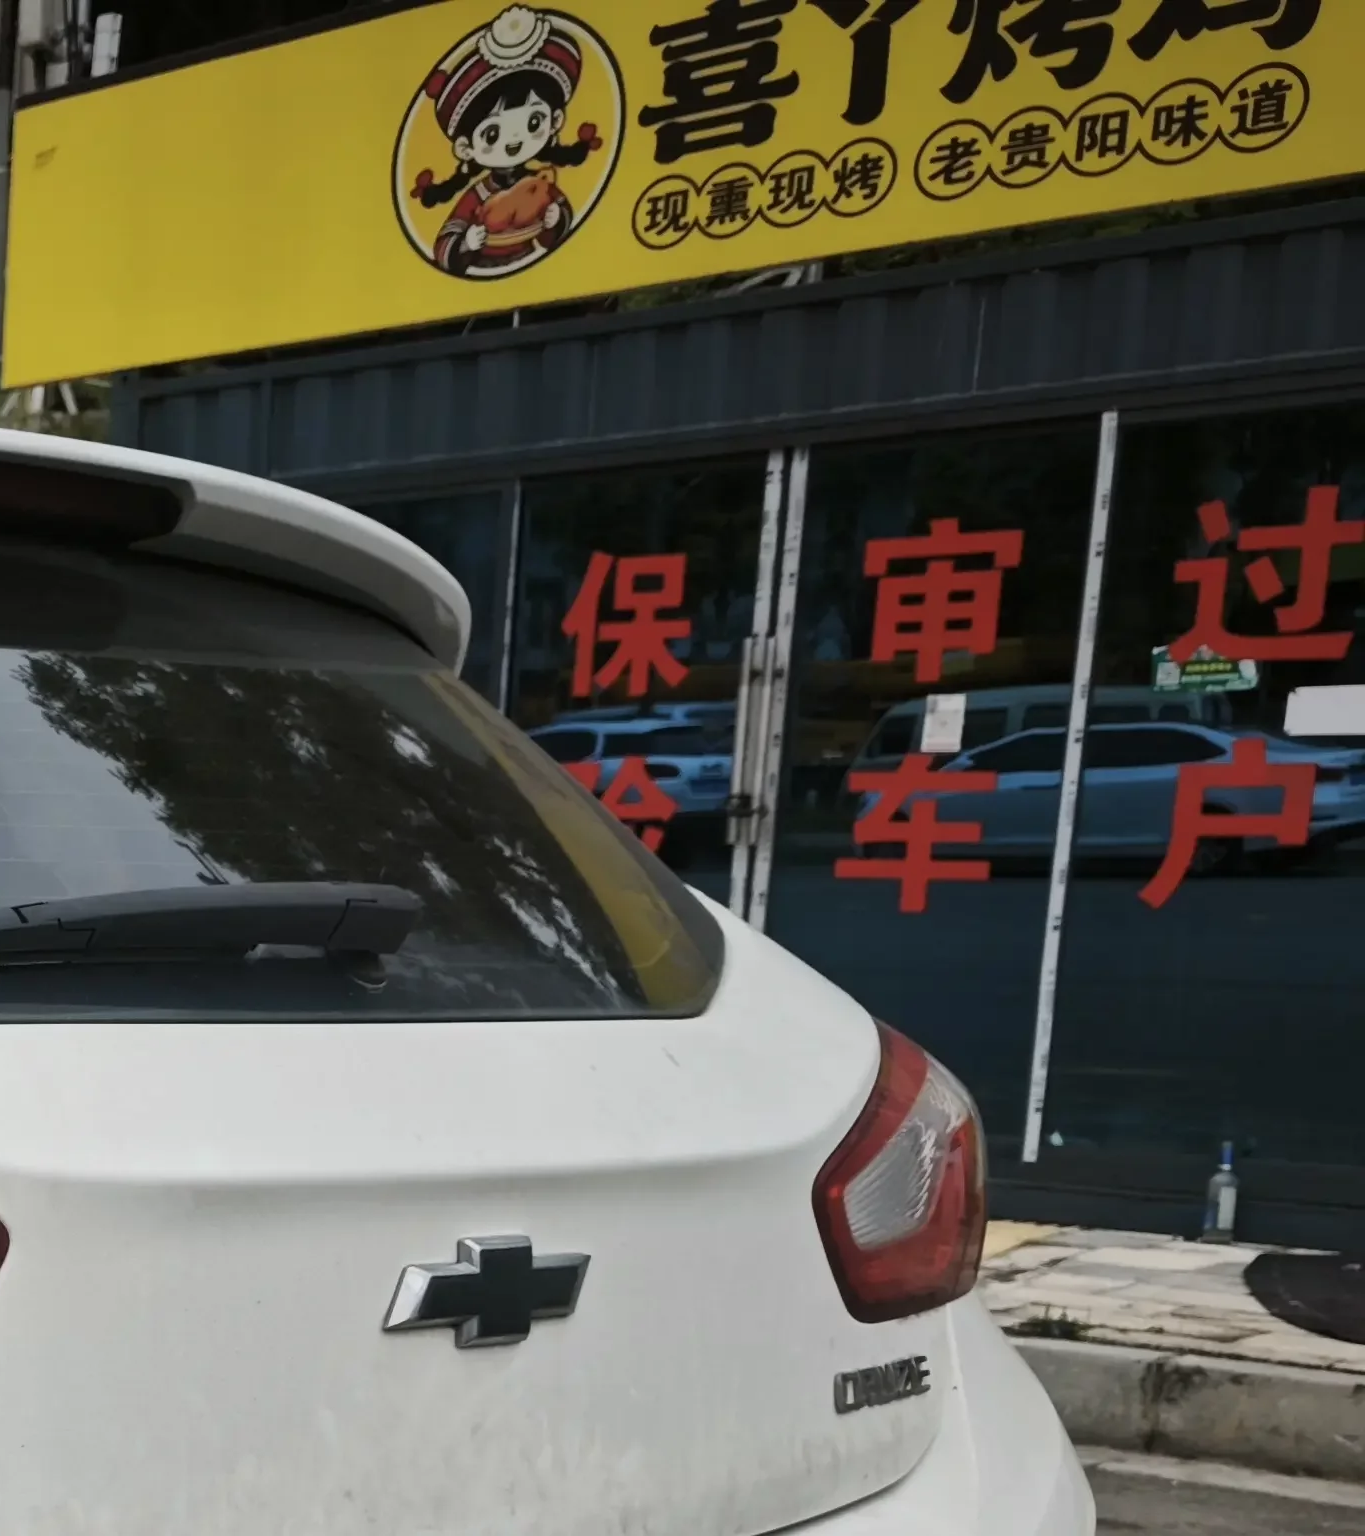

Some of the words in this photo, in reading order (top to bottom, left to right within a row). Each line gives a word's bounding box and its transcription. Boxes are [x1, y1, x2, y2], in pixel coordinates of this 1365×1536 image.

[637, 0, 1322, 165] 喜丫烤
[928, 78, 1294, 185] 老贵阳味道
[642, 151, 886, 238] 现熏现烤
[833, 517, 1024, 913] 审车
[1137, 485, 1365, 909] 过户
